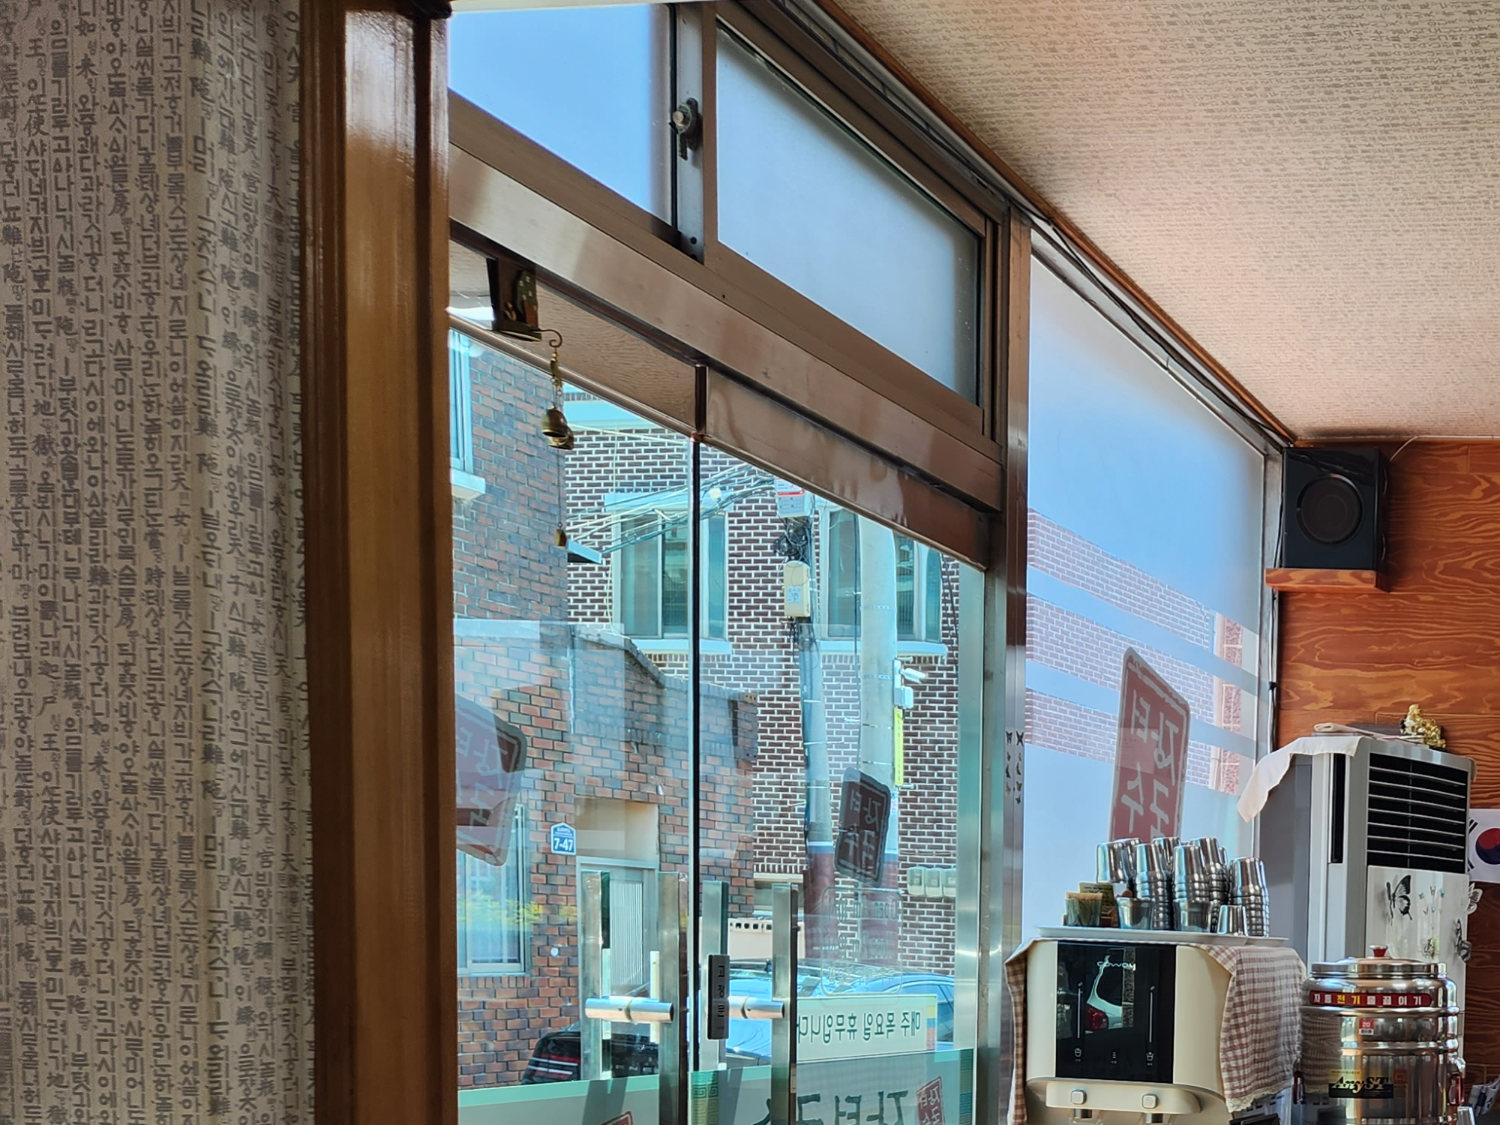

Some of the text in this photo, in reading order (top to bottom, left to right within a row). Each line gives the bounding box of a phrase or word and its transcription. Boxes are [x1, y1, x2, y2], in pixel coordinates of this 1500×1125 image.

[553, 837, 574, 852] 7-47
[1096, 960, 1137, 972] coway
[1332, 1076, 1389, 1094] AnyST
